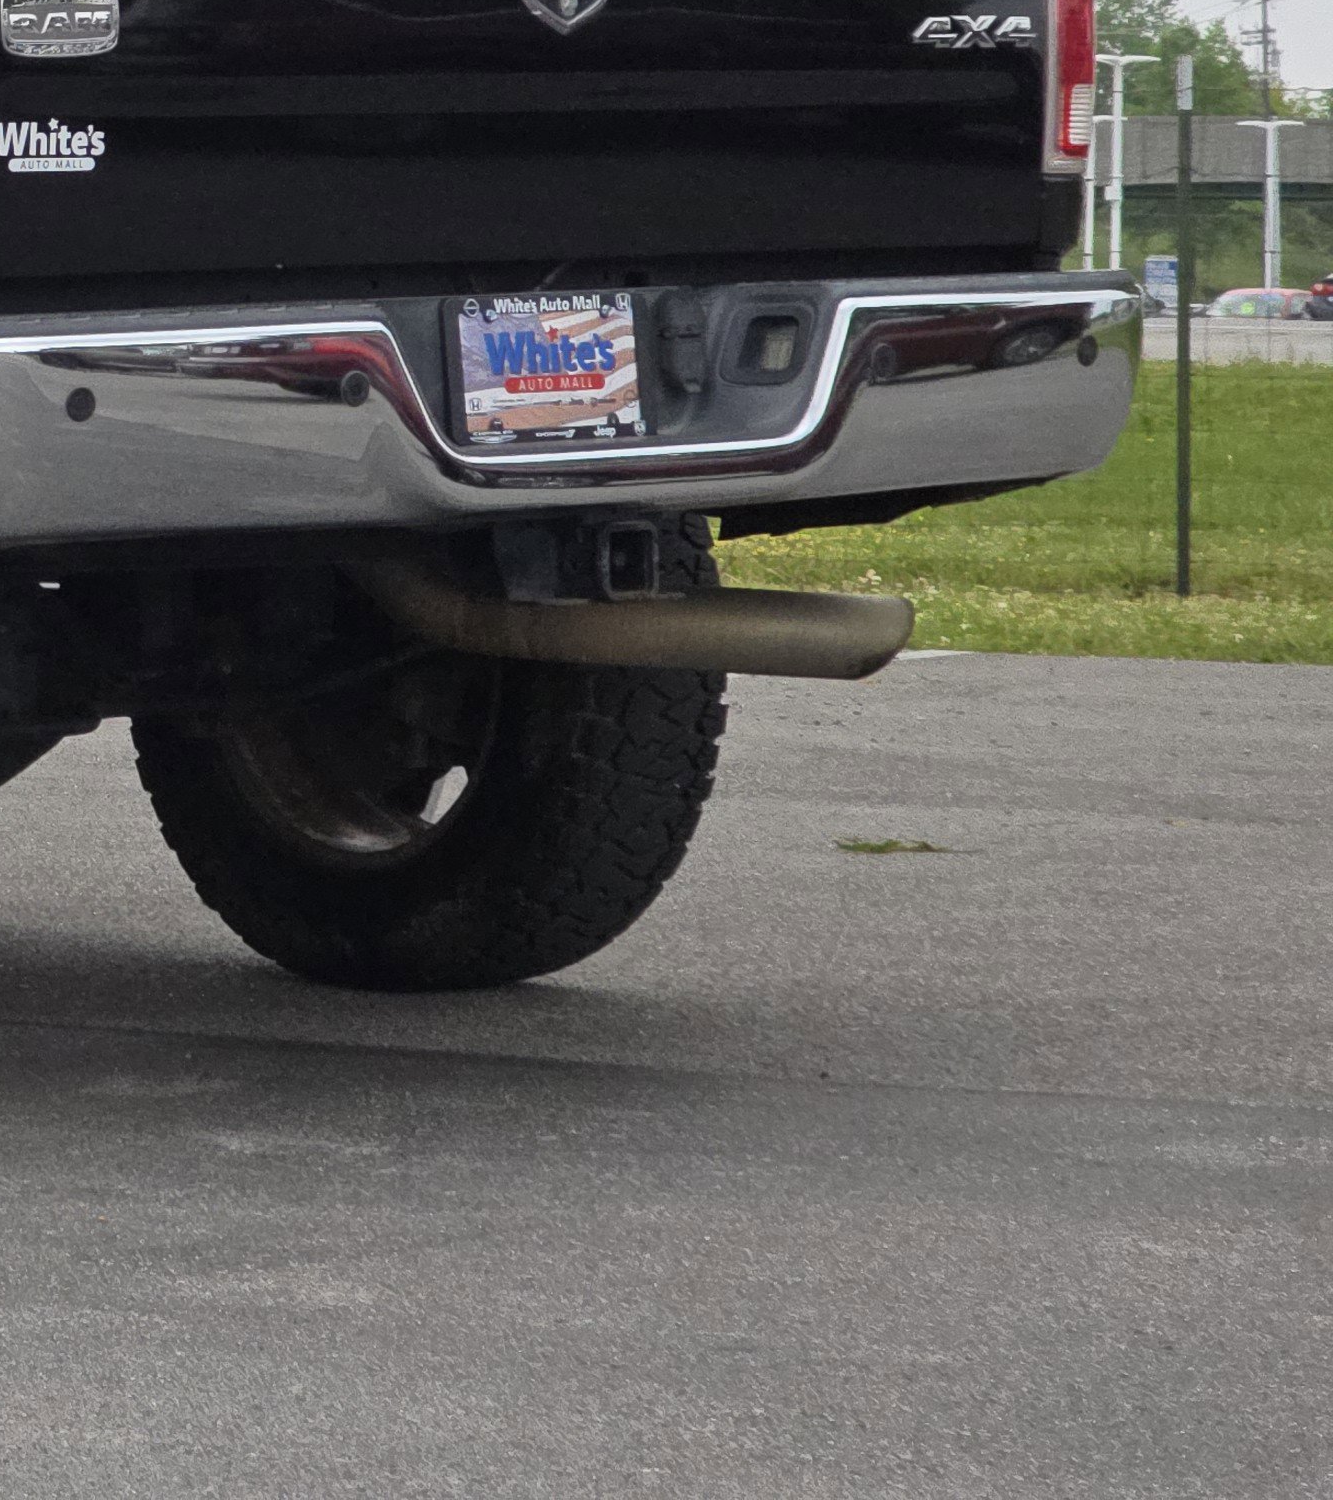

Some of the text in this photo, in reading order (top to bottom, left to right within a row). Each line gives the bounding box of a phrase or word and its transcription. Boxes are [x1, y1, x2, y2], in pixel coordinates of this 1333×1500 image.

[20, 159, 84, 170] AUTO MALL
[493, 295, 601, 315] White's Auto Mall
[484, 325, 617, 376] White's
[519, 375, 594, 392] AUTO MALL
